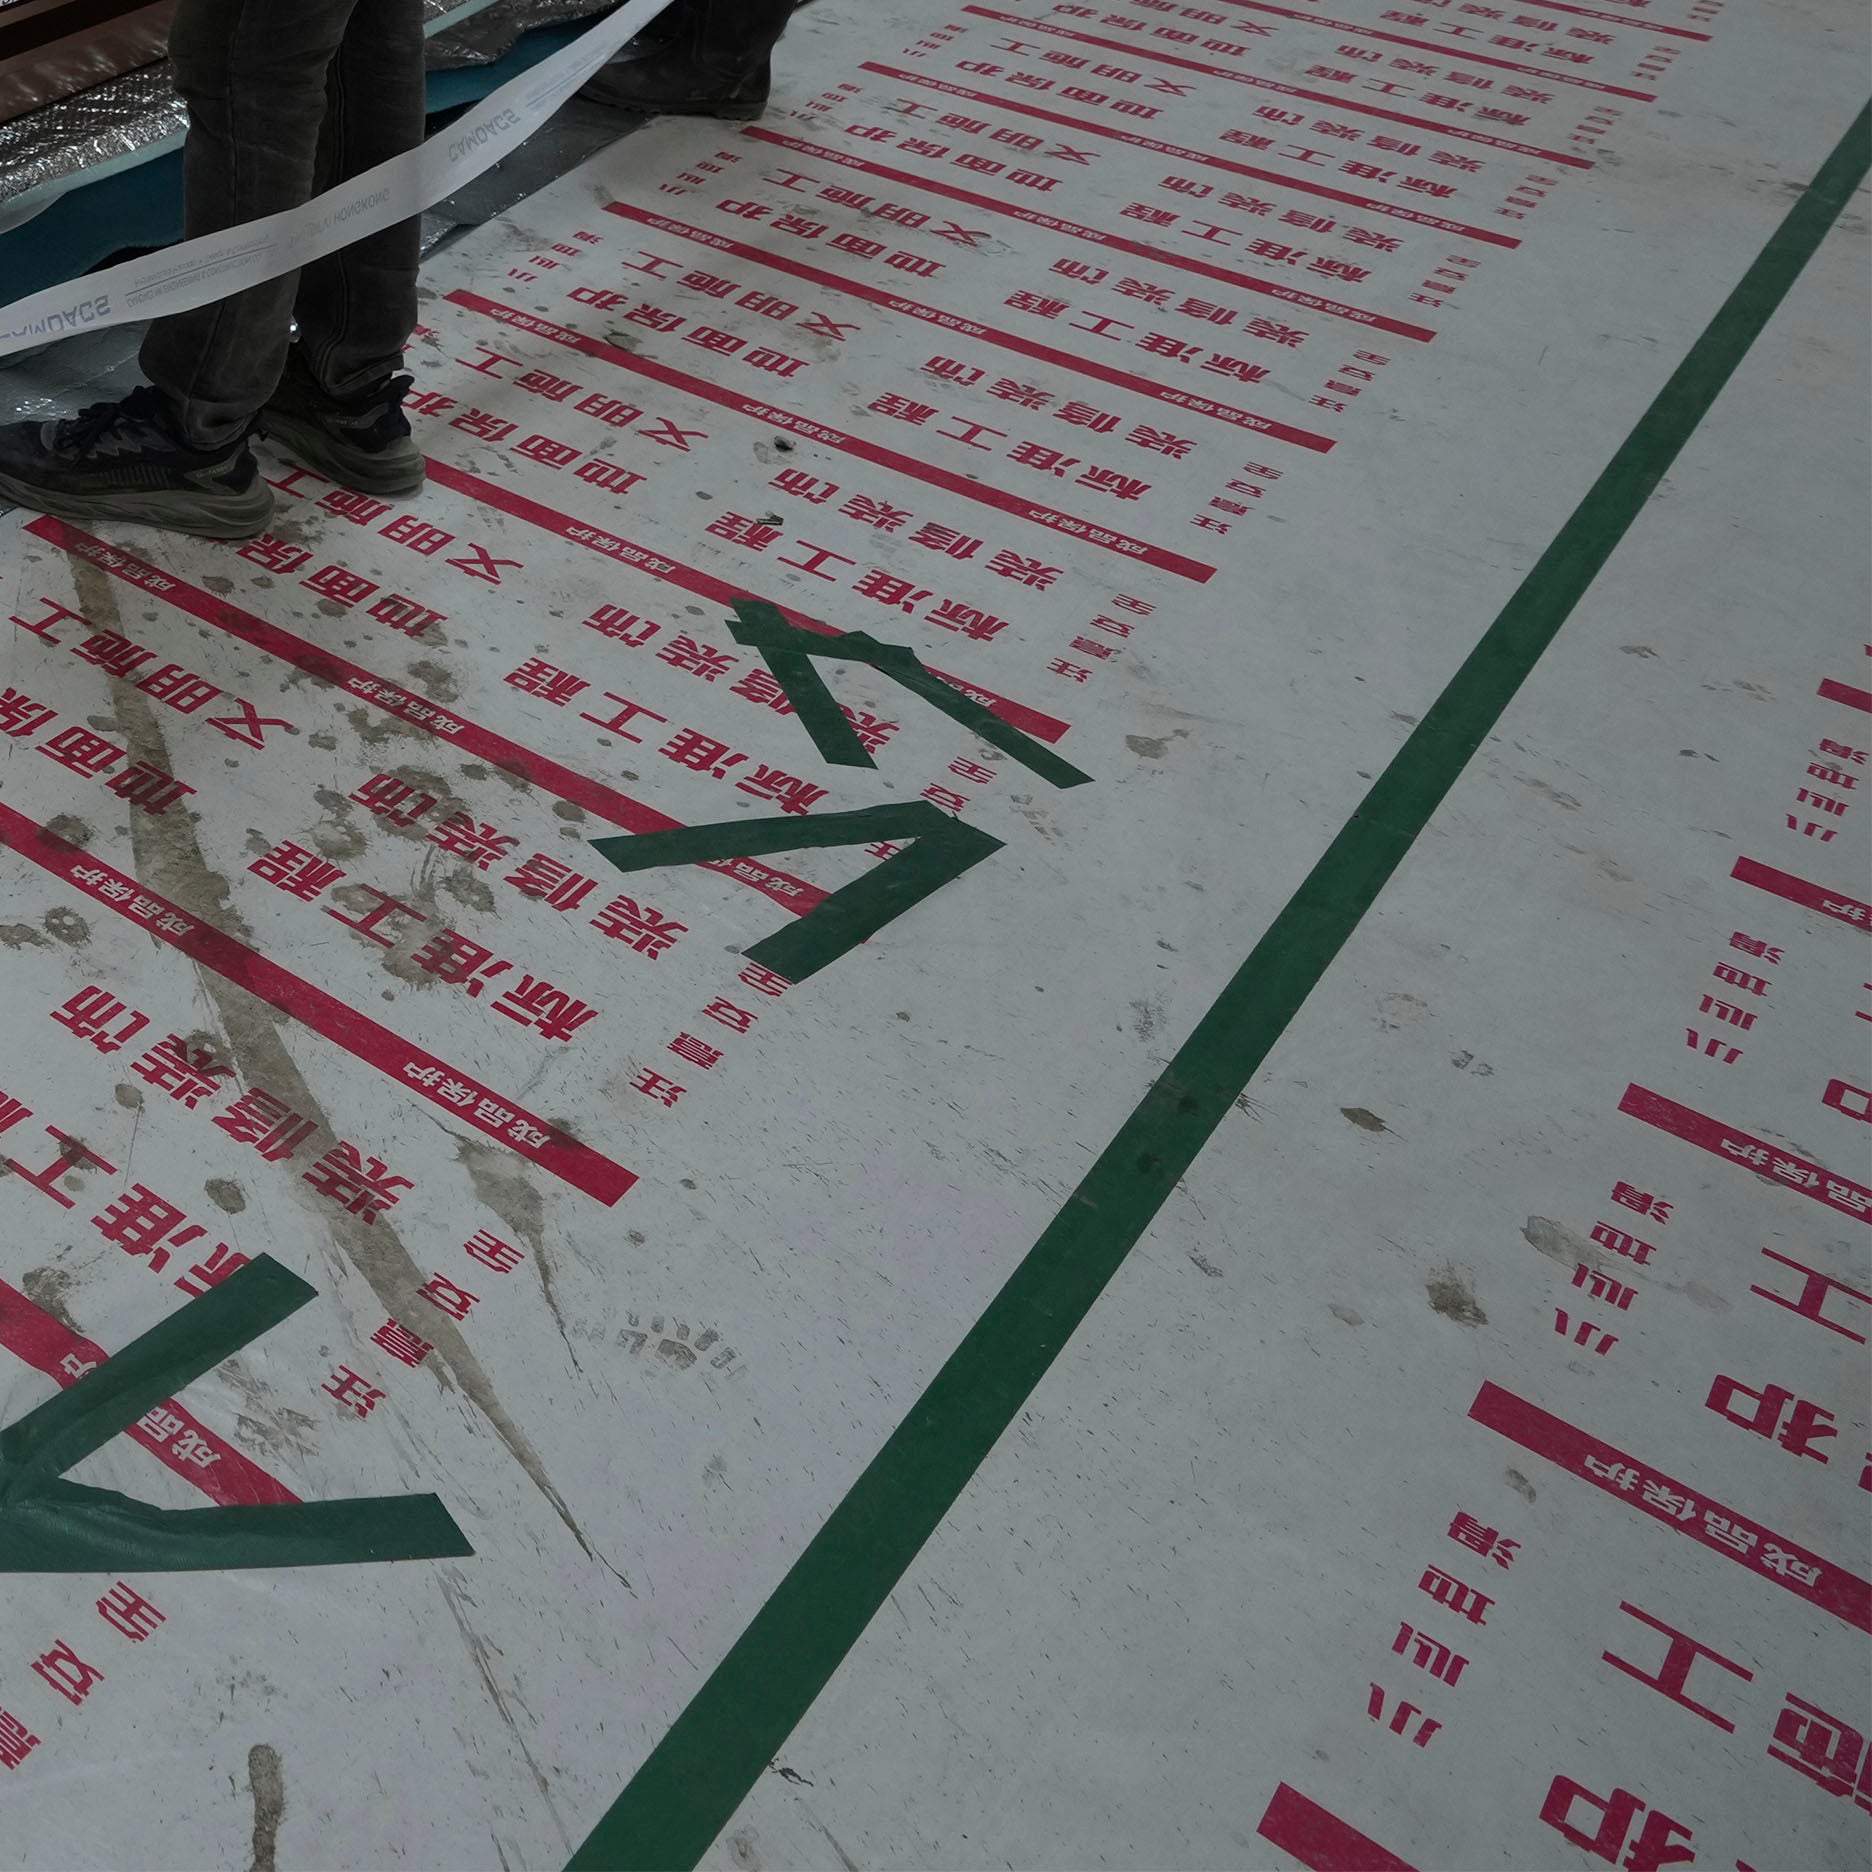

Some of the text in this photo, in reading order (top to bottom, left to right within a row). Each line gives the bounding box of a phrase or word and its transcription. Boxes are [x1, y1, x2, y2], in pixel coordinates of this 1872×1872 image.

[957, 61, 1159, 119] 地面保护
[1007, 42, 1186, 95] 文明施工
[846, 125, 1059, 191] 地面保护
[903, 102, 1093, 164] 文明施工
[1221, 130, 1455, 198] 标准工程
[1257, 106, 1478, 172] 装修装饰
[718, 200, 941, 276] 地面保护
[768, 174, 979, 244] 文明施工
[1121, 204, 1369, 282] 标准工程
[1163, 176, 1397, 252] 装修装饰
[509, 232, 597, 281] 小心地滑
[635, 252, 853, 340] 文明施工
[482, 304, 583, 345] 成品保护
[569, 288, 807, 376] 地面保护
[1006, 293, 1268, 382] 标准工程
[1055, 259, 1302, 347] 装修装饰
[401, 390, 645, 494] 地面保护
[459, 348, 707, 451] 文明施工
[737, 399, 848, 445] 成品保护
[928, 357, 1191, 459] 装修装饰
[870, 394, 1150, 500] 标准工程
[771, 469, 1061, 590] 装修装饰
[1024, 506, 1150, 559] 成品保护
[1188, 460, 1286, 536] 注意安全
[558, 521, 677, 575] 成品保护
[707, 512, 1008, 641] 标准工程
[10, 598, 291, 749] 文明施工
[1043, 592, 1157, 685] 注意安全
[340, 670, 467, 737] 成品保护
[506, 659, 827, 815] 标准工程
[1785, 737, 1868, 842] 小心地滑
[62, 858, 198, 941] 成品保护
[350, 774, 687, 959] 装修装饰
[249, 841, 597, 1041] 标准工程
[1686, 930, 1784, 1065] 小心地滑
[51, 986, 413, 1224] 装修装饰
[398, 1054, 558, 1156] 成品保护
[1554, 1179, 1675, 1358] 小心地滑
[324, 1231, 523, 1416] 注意安全
[1584, 1450, 1823, 1590] 成品保护
[1366, 1509, 1521, 1749] 小心地滑
